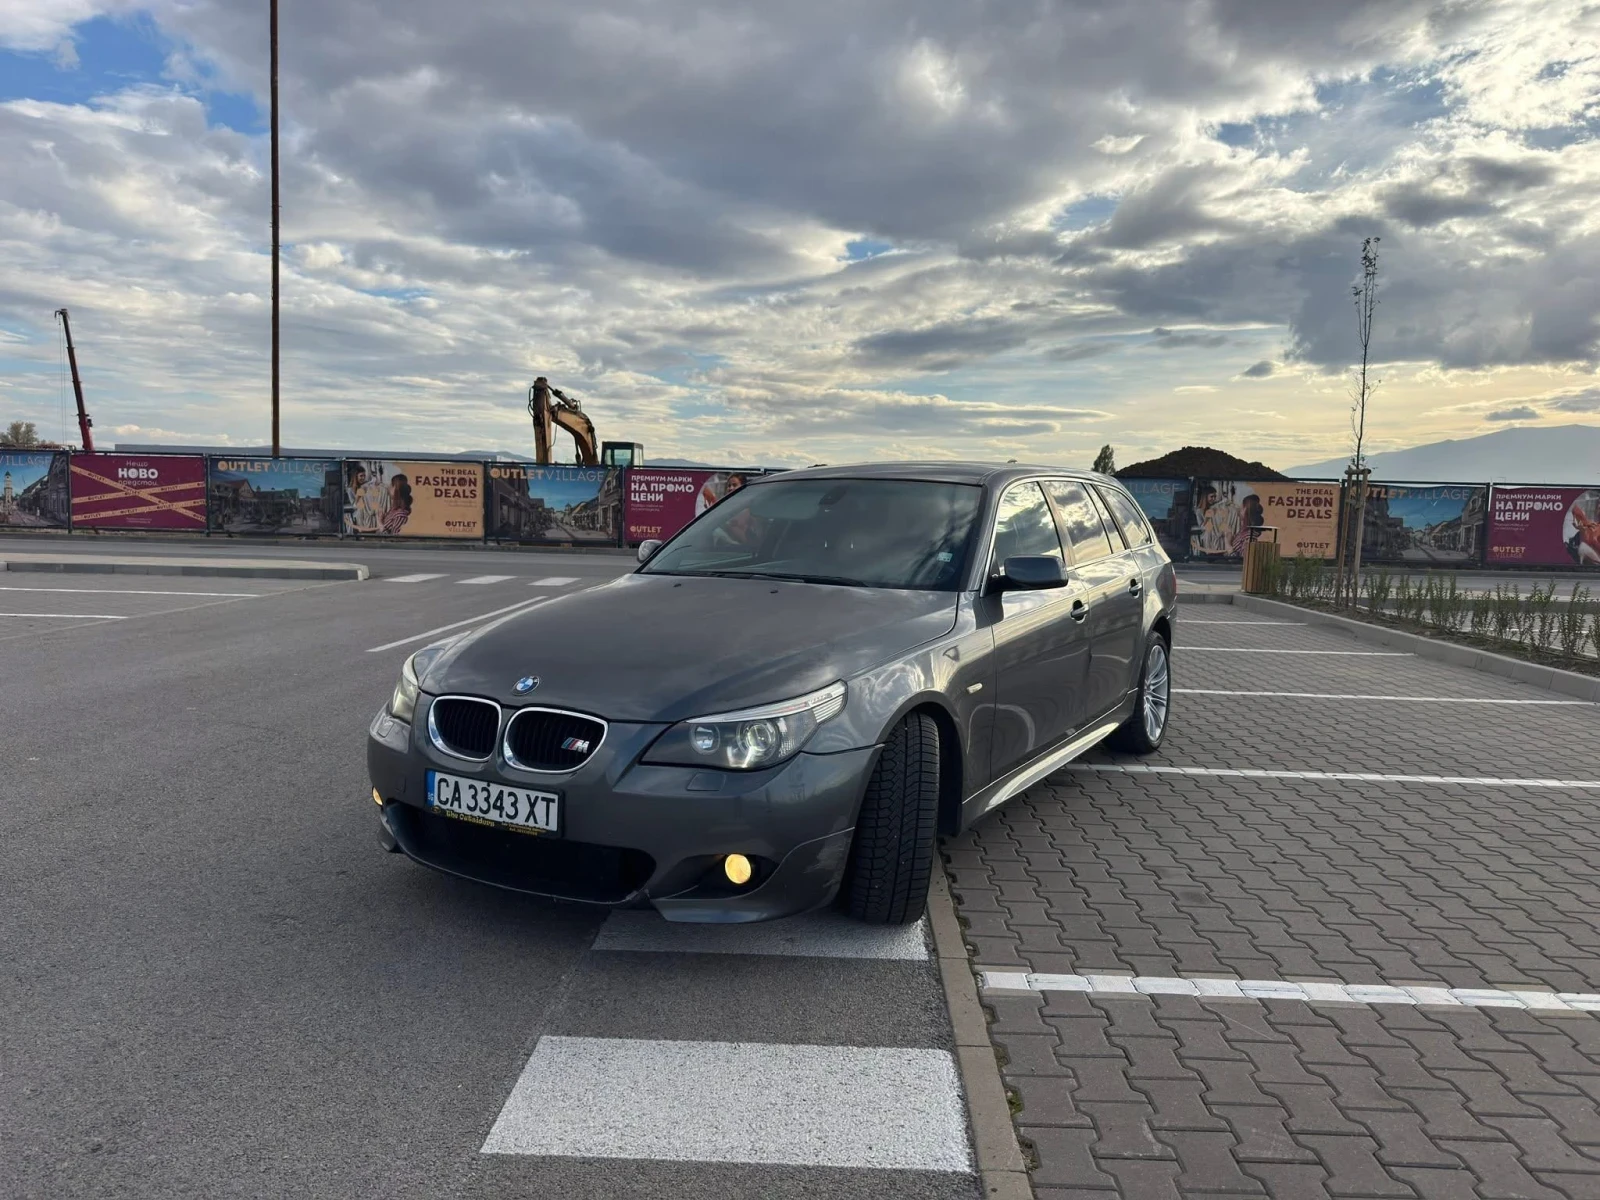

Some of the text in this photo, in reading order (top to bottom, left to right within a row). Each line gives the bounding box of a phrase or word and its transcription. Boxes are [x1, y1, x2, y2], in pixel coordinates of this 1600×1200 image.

[118, 467, 159, 479] НОВО
[415, 475, 477, 487] FASHION
[631, 482, 694, 493] НА ПРОМО
[434, 488, 477, 499] DEALS
[631, 492, 664, 502] ЦЕНИ
[1268, 496, 1333, 507] FASHION
[1495, 501, 1563, 511] НА ПРОМО
[1287, 508, 1332, 519] DEALS
[1495, 511, 1530, 521] ЦЕНИ
[445, 520, 477, 528] OUTLET
[629, 525, 662, 533] OUTLET
